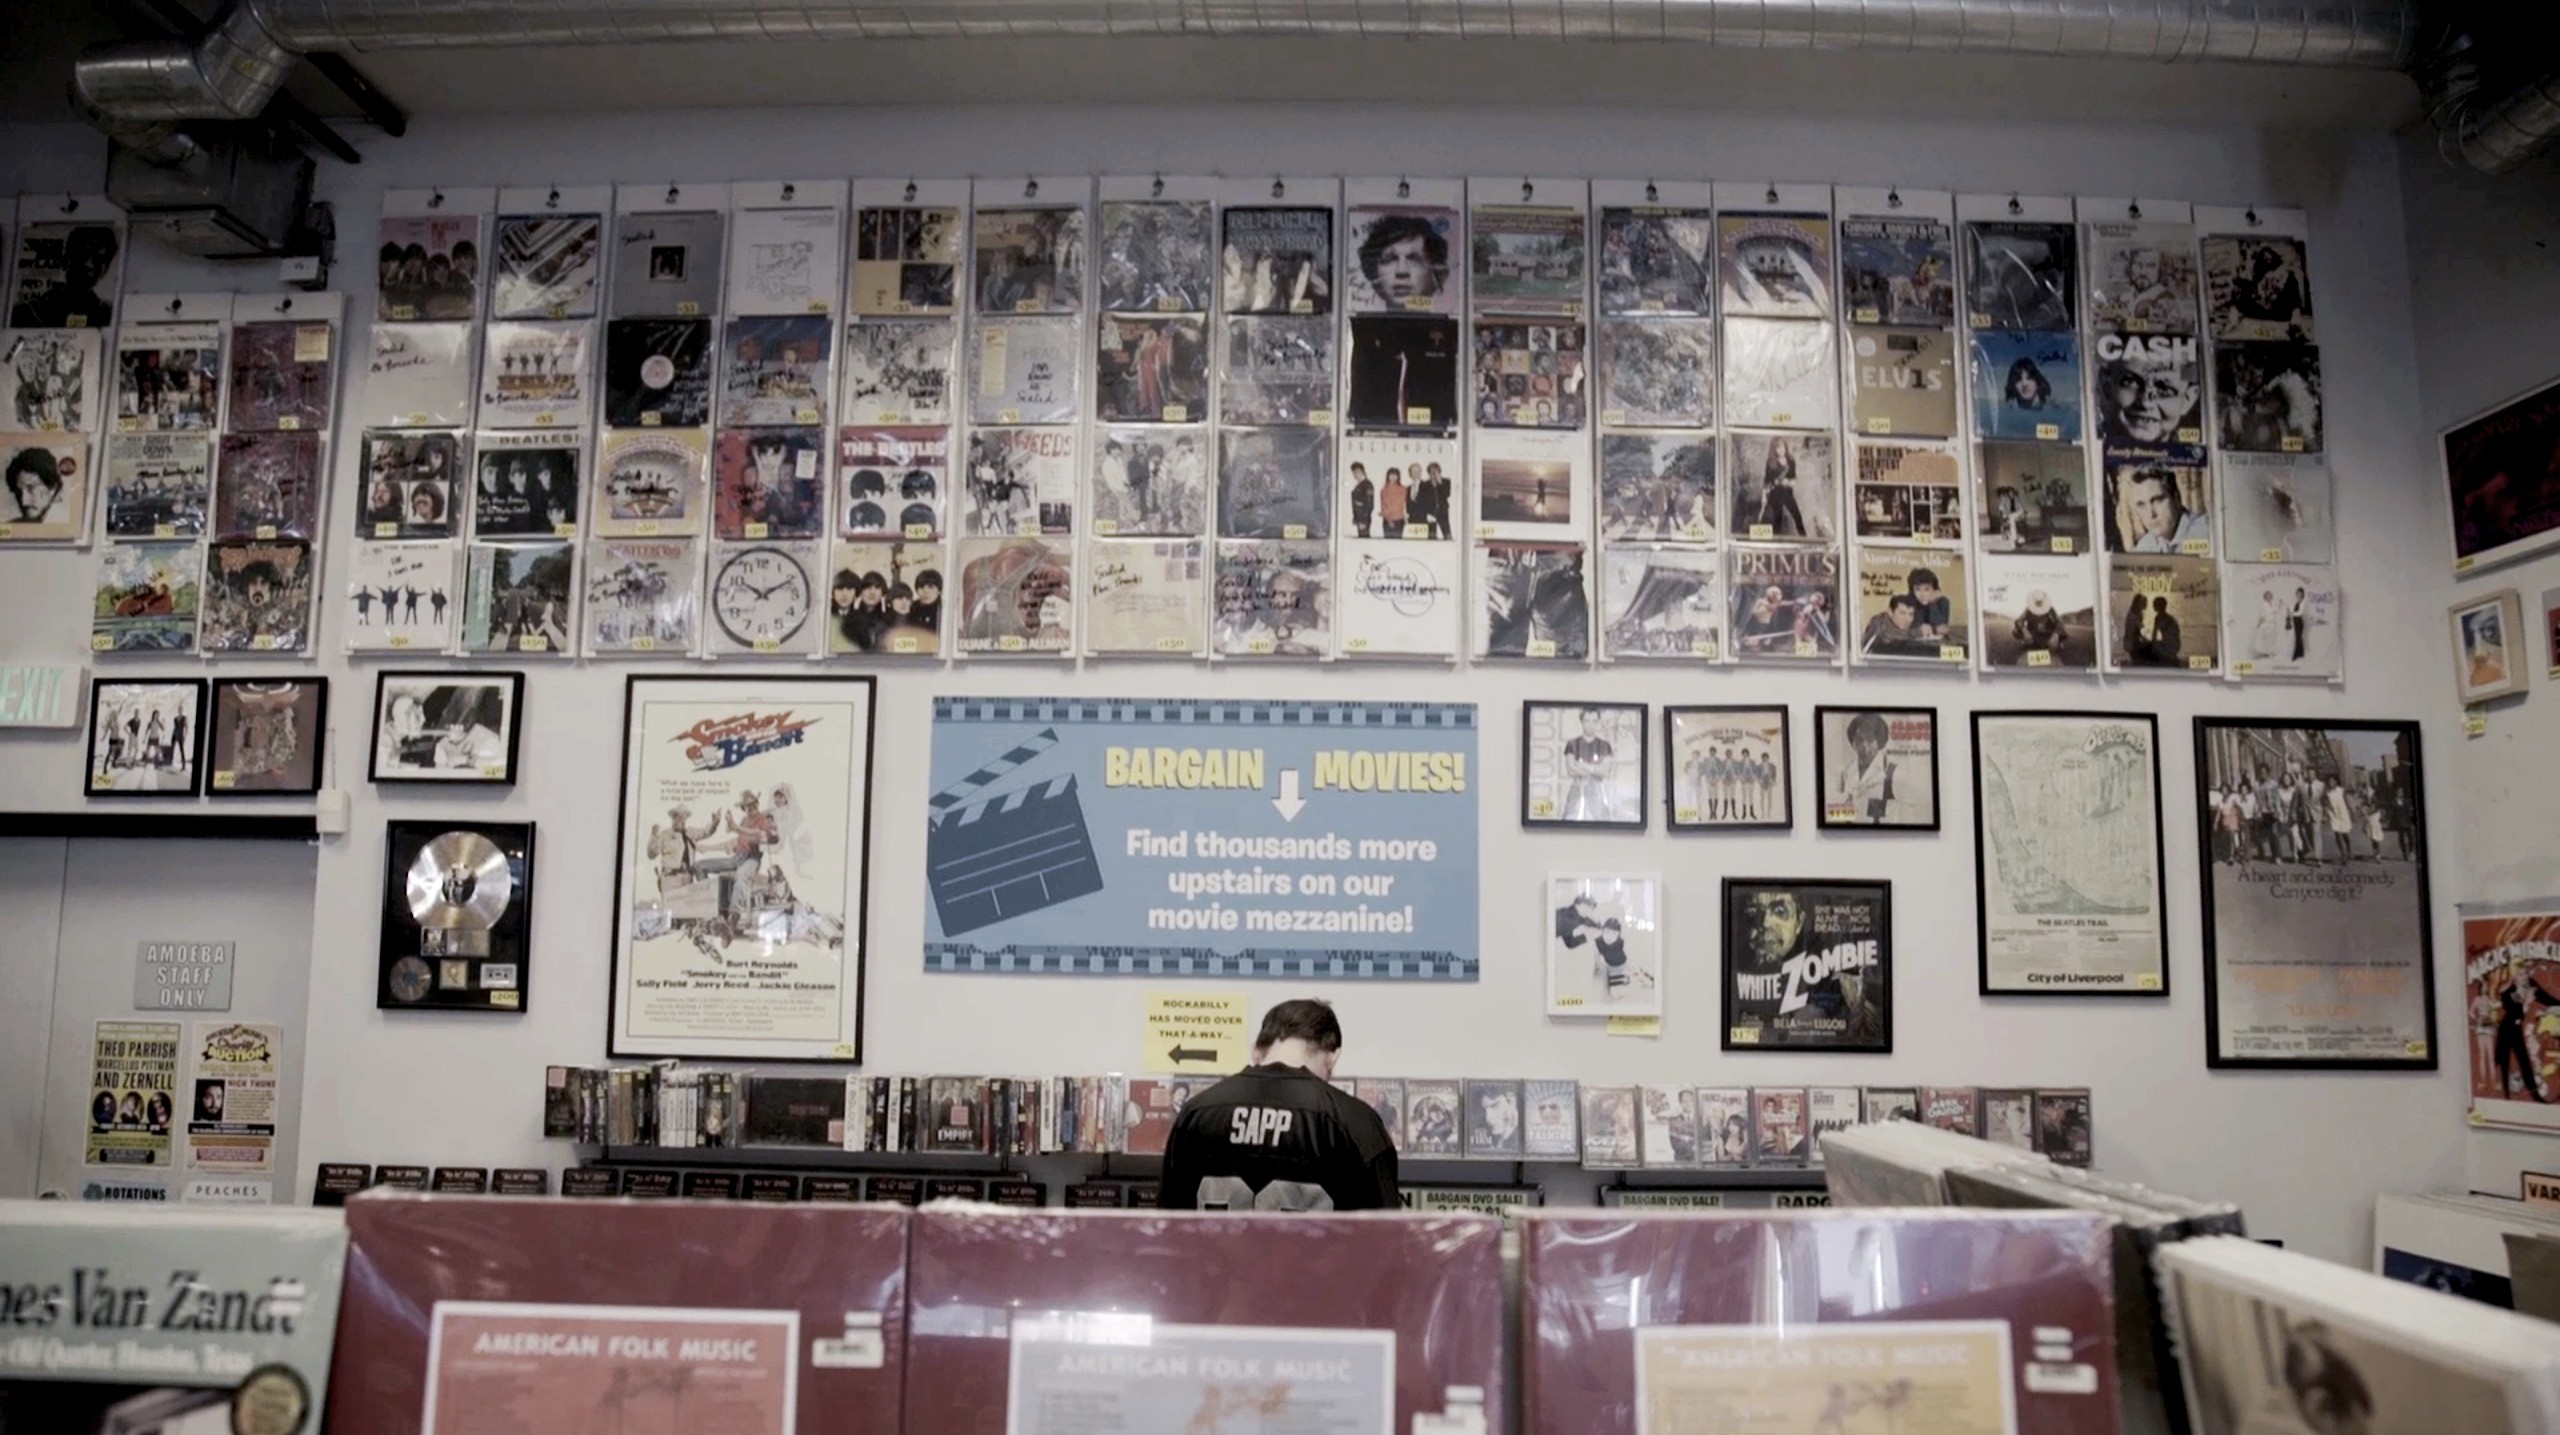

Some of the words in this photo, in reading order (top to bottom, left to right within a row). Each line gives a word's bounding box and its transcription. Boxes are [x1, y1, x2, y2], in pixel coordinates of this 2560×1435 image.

[2096, 334, 2197, 363] CASH
[499, 434, 579, 445] BEATLES!
[843, 441, 873, 456] THE
[1736, 552, 1835, 575] PRIMUS
[0, 667, 64, 720] EXIT
[1104, 746, 1264, 790] BARGAIN
[1313, 749, 1466, 794] MOVIES!
[1126, 829, 1187, 858] Find
[1195, 832, 1351, 861] thousands
[1359, 839, 1437, 862] more
[1168, 866, 1291, 900] upstairs
[1298, 873, 1336, 895] on
[1342, 873, 1394, 896] our
[2238, 868, 2250, 883] A
[2251, 868, 2288, 884] heart
[2291, 868, 2314, 884] and
[2316, 868, 2342, 884] soul
[2269, 884, 2297, 899] Can
[2299, 887, 2325, 902] you
[1148, 903, 1238, 931] movie
[1245, 905, 1414, 933] mezzanine!
[147, 945, 225, 963] AMOEBA
[751, 960, 798, 969] Reynolds
[157, 966, 213, 984] STAFF
[1736, 972, 1782, 1001] WHITE
[1778, 939, 1878, 1015] ZOMBIE
[2027, 973, 2052, 984] City
[2053, 973, 2066, 983] of
[2068, 973, 2124, 984] Liverpool
[636, 980, 661, 989] Sally
[663, 980, 688, 988] Field
[160, 988, 205, 1006] ONLY
[1163, 1000, 1230, 1009] ROCKABILLY
[1149, 1014, 1171, 1023] HAS
[1174, 1015, 1211, 1024] MOVED
[1213, 1016, 1243, 1025] OVER
[1773, 1018, 1797, 1029] BELA
[1813, 1018, 1847, 1030] LUGOSI
[97, 1041, 125, 1057] THEO
[129, 1041, 177, 1058] PARRISH
[94, 1072, 120, 1089] AND
[122, 1072, 173, 1090] ZERNELL
[1229, 1106, 1293, 1147] SAPP
[104, 1187, 166, 1201] ROTATIONS
[196, 1185, 258, 1196] PEACHES
[1426, 1193, 1470, 1204] BARGAIN
[1473, 1193, 1493, 1204] DVD
[1496, 1194, 1523, 1204] SALE!
[1623, 1195, 1667, 1206] BARGAIN
[1670, 1196, 1690, 1206] DVD
[1692, 1195, 1719, 1206] SALE!
[71, 1266, 148, 1329] Van
[473, 1332, 600, 1359] AMERICAN
[609, 1335, 669, 1360] FOLK
[679, 1338, 759, 1363] MUSIC
[1058, 1353, 1189, 1378] AMERICAN
[1199, 1355, 1261, 1379] FOLK
[1273, 1357, 1353, 1382] MUSIC
